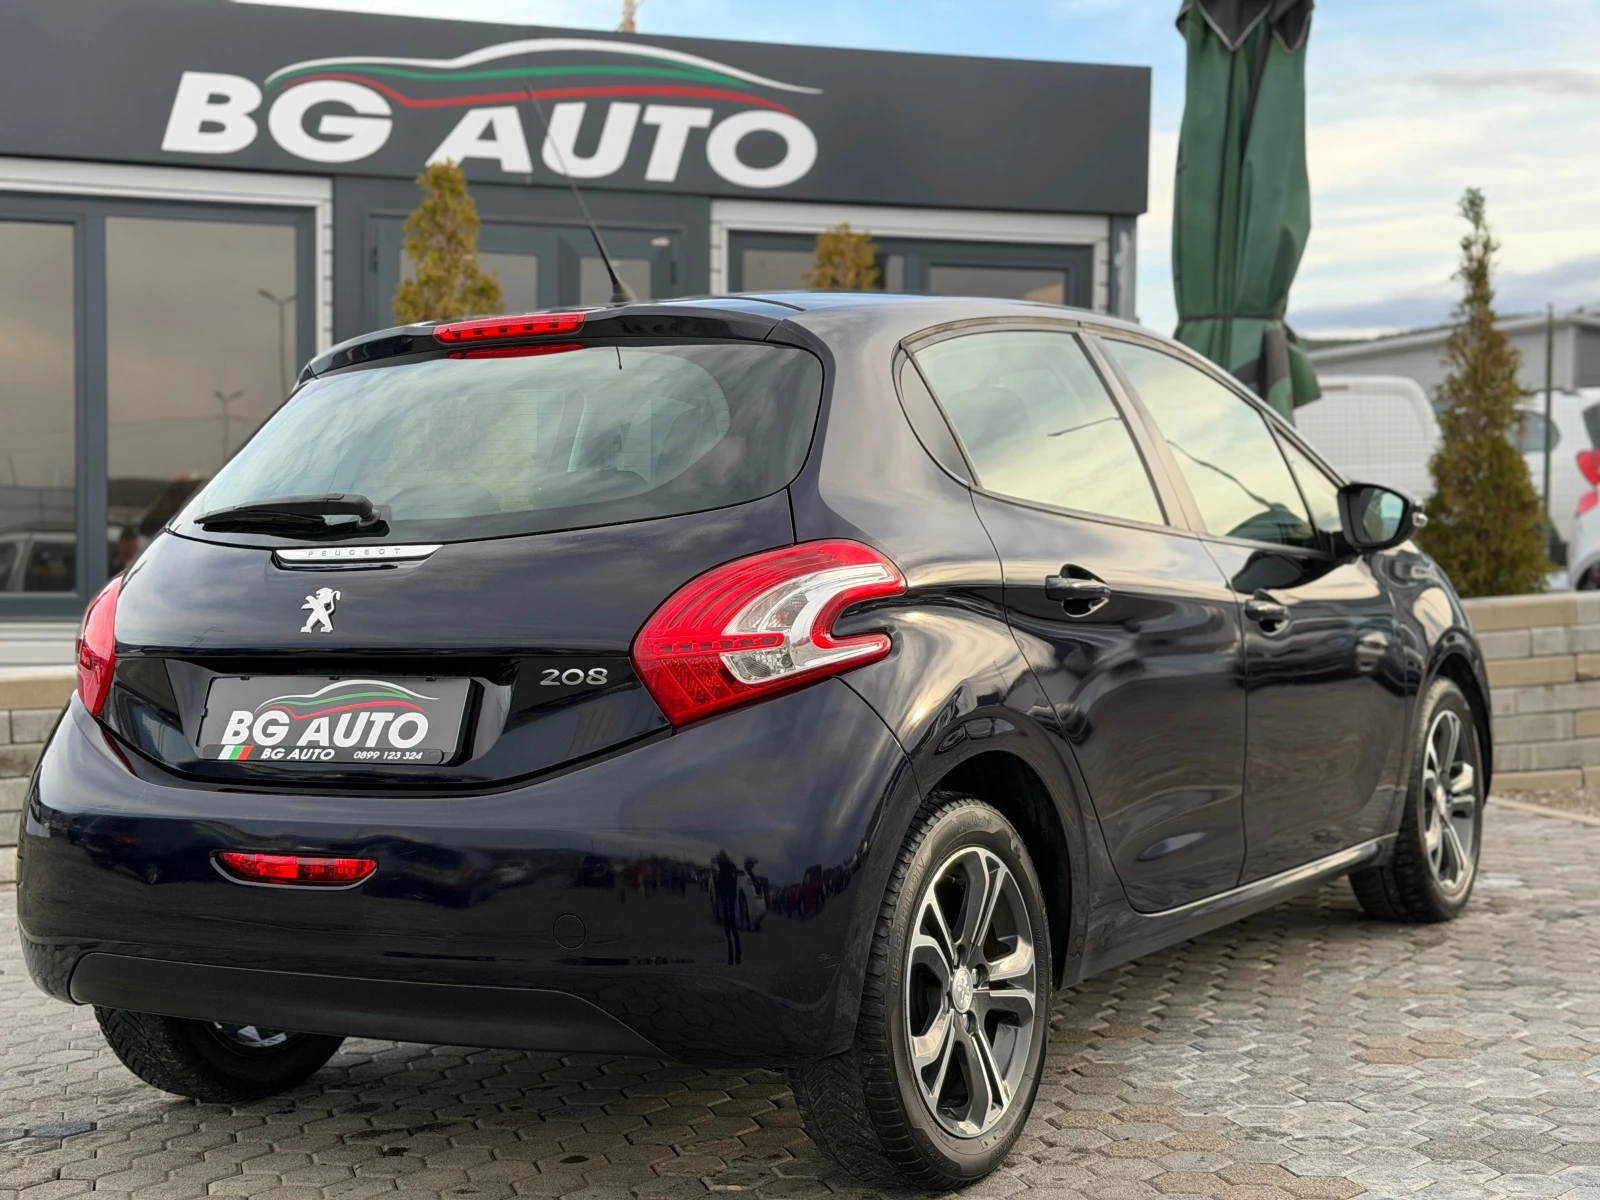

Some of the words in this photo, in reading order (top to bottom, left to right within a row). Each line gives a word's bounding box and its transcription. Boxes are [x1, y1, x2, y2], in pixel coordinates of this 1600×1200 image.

[161, 71, 393, 163] BG
[424, 102, 818, 188] AUTO
[308, 548, 401, 557] PEUGEOT
[539, 667, 609, 686] 208
[220, 710, 290, 746] BG
[296, 711, 429, 749] AUTO
[260, 748, 286, 760] BG
[286, 748, 336, 760] AUTO
[353, 750, 380, 760] 0899
[382, 751, 402, 760] 123
[402, 751, 423, 760] 324
